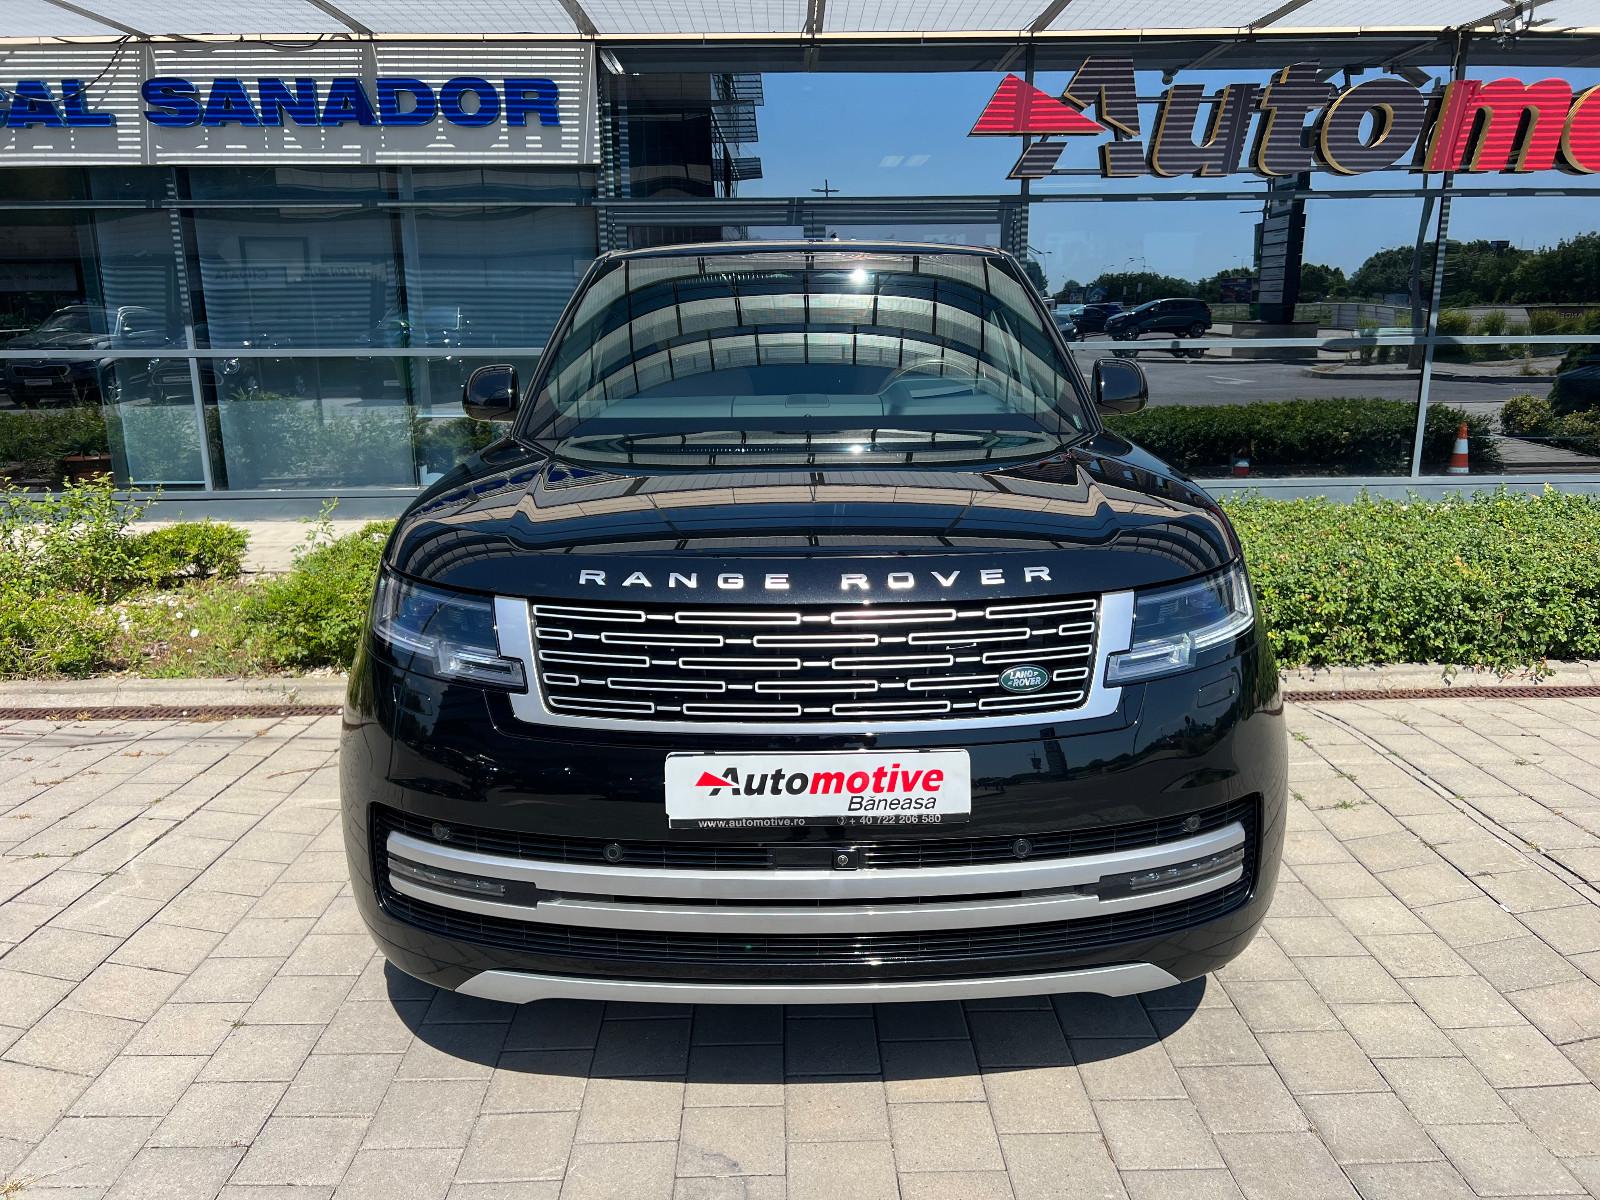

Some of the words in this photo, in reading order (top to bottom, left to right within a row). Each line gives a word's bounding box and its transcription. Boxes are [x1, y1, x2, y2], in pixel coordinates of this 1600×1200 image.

[0, 79, 118, 129] AL
[141, 76, 562, 129] SANADOR
[578, 568, 790, 591] RANGE
[840, 565, 1053, 591] ROVER
[1009, 670, 1033, 680] LAND
[1012, 677, 1042, 687] ROVER
[706, 763, 944, 796] Automotive
[847, 795, 936, 811] Băneasa
[698, 817, 806, 829] www.automotive.ro
[859, 815, 873, 825] 40
[876, 815, 896, 825] 722
[899, 815, 919, 824] 206
[921, 814, 942, 824] 580
